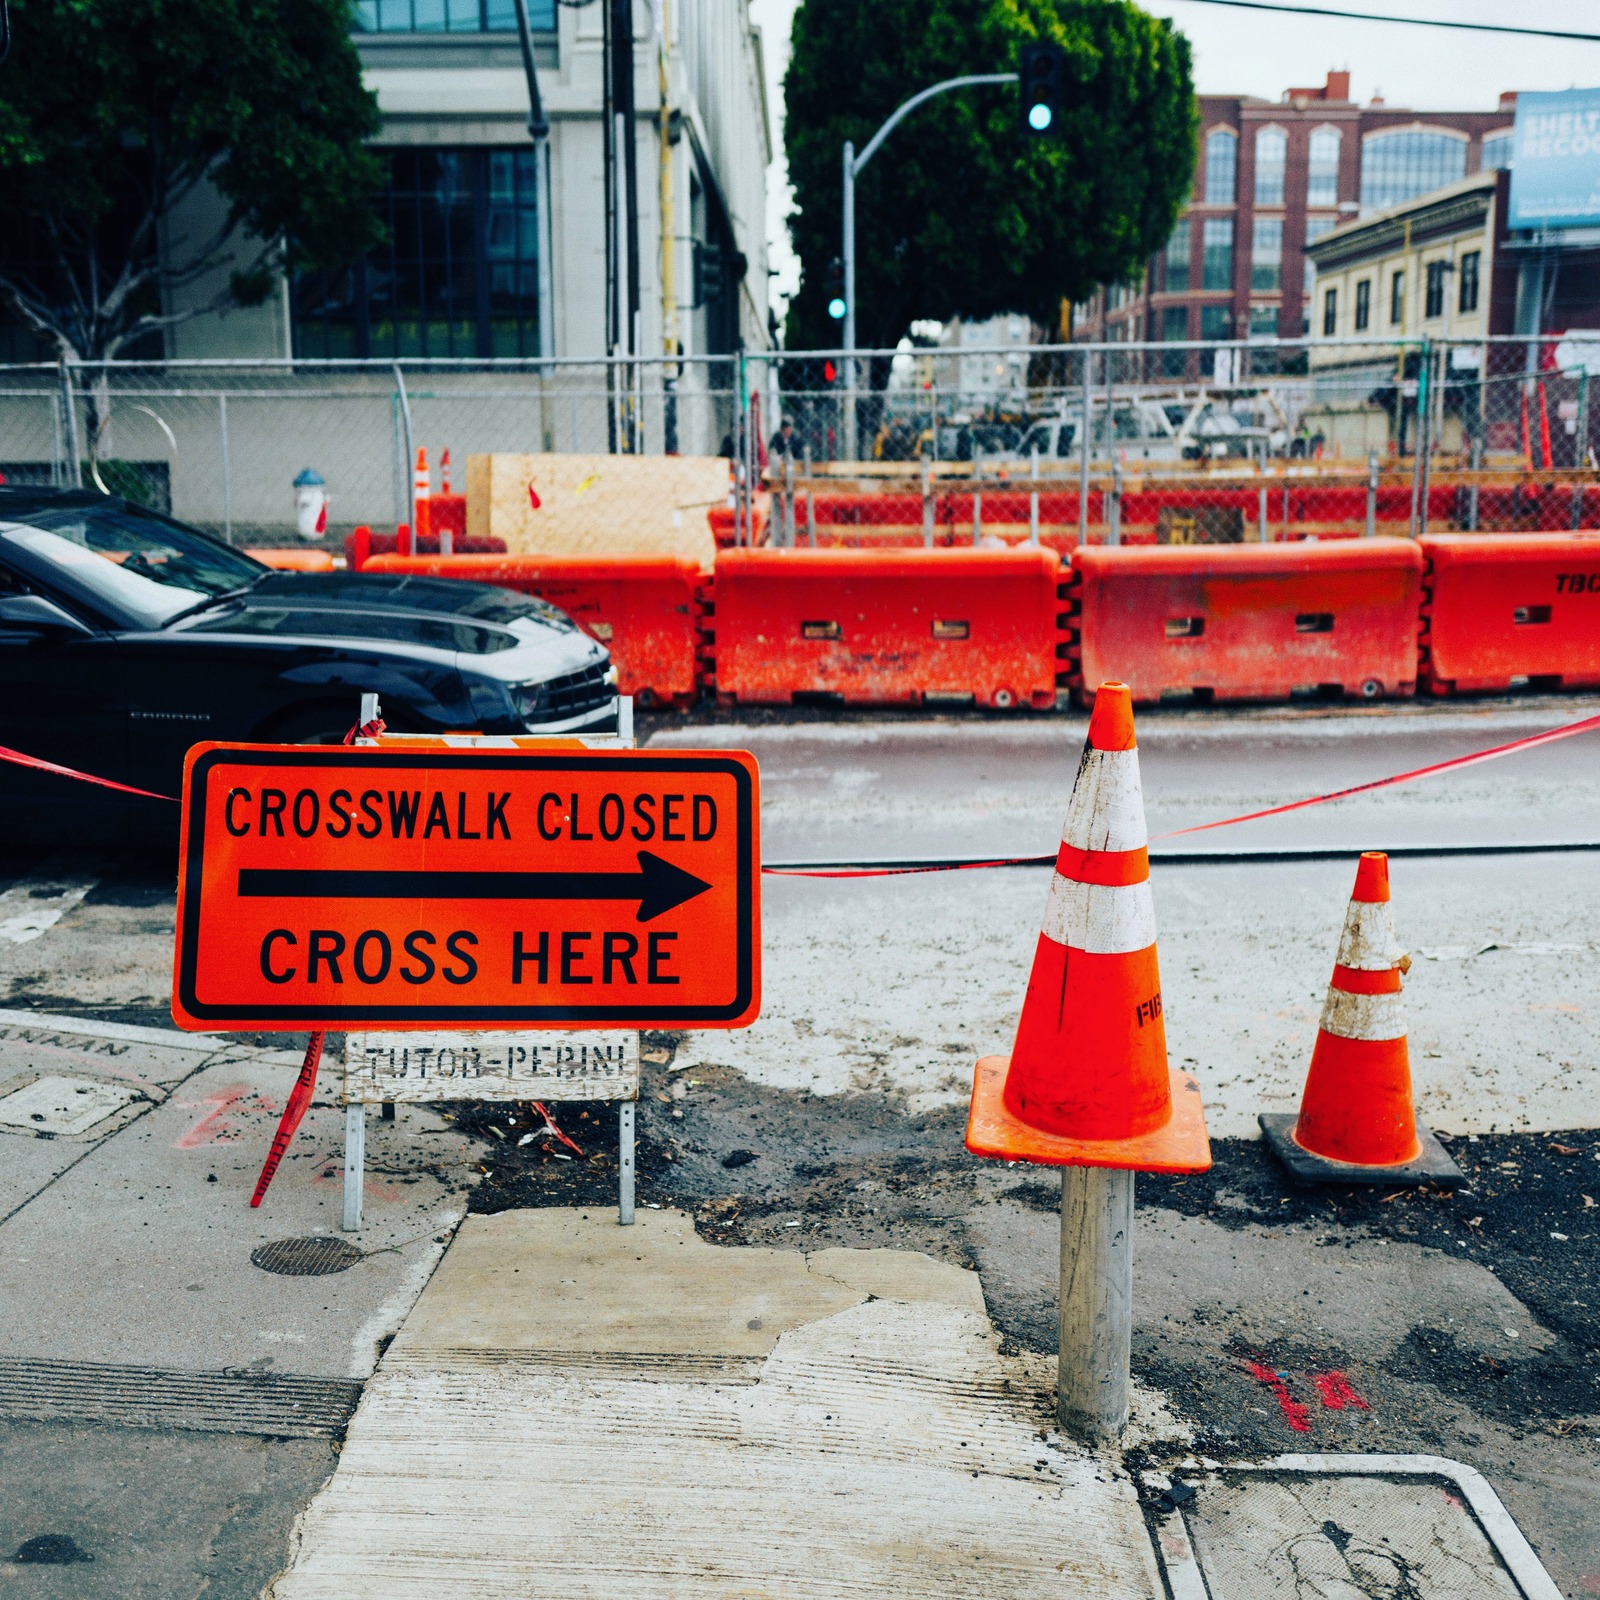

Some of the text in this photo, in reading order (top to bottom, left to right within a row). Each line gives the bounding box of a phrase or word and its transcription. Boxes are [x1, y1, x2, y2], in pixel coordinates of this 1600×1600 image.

[130, 711, 210, 721] CAMARO
[225, 787, 718, 842] CROSSWALK CLOSED
[259, 928, 680, 985] CROSS HERE
